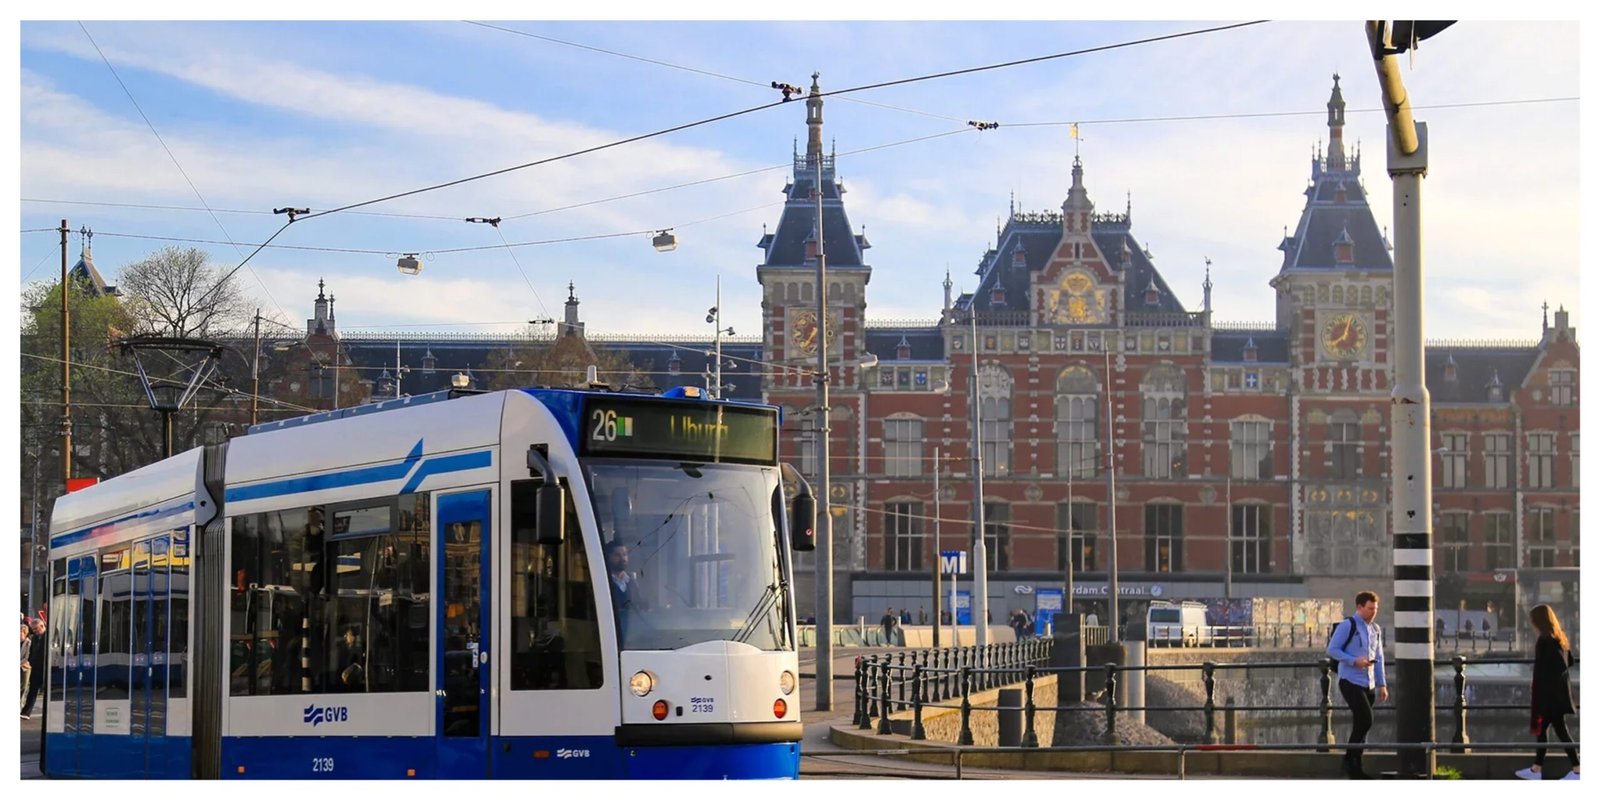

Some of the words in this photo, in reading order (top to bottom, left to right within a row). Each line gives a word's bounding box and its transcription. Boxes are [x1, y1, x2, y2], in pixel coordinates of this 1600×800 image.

[592, 409, 617, 442] 26
[941, 556, 958, 574] M
[325, 706, 348, 722] GVB
[692, 704, 714, 713] 2139
[572, 749, 590, 758] GVB
[312, 757, 334, 772] 2139
